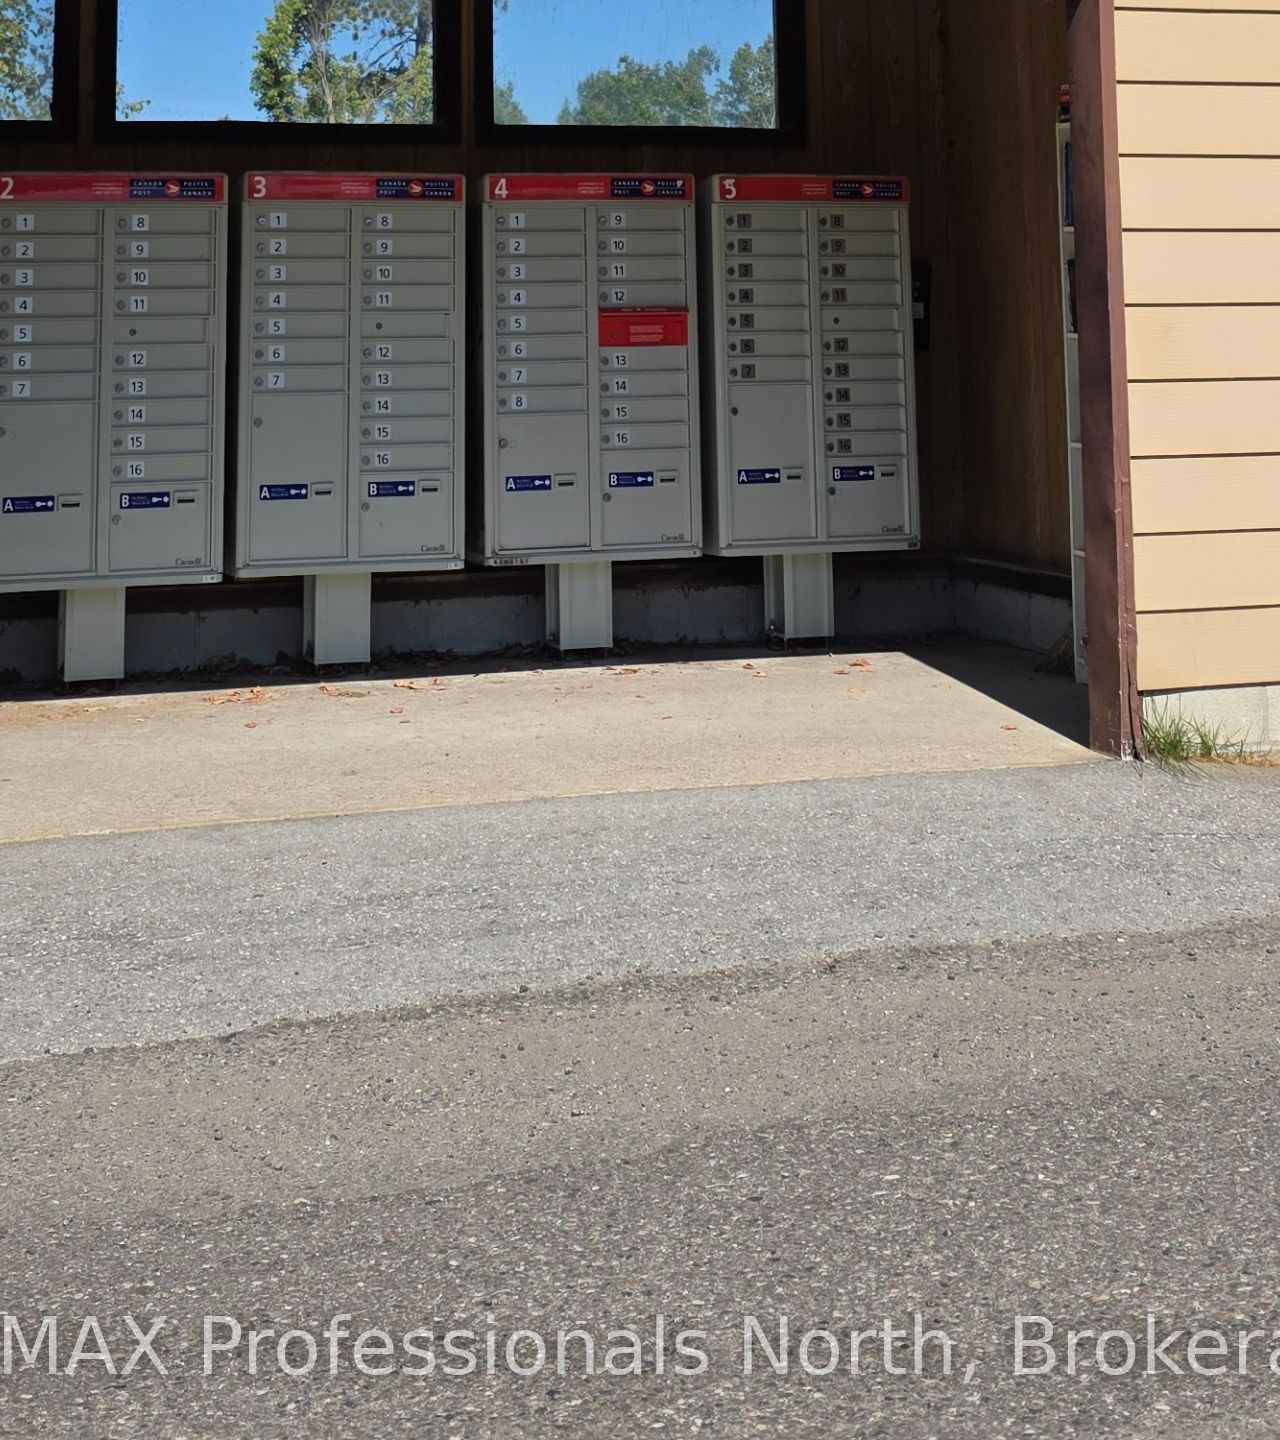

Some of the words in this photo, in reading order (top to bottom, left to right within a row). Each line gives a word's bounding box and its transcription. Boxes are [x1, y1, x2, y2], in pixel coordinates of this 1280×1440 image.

[0, 178, 14, 200] 2
[253, 176, 267, 198] 3
[494, 178, 508, 198] 4
[722, 179, 736, 198] 5
[136, 217, 145, 228] 8
[381, 215, 389, 227] 8
[614, 215, 622, 225] 9
[833, 215, 841, 227] 8
[21, 245, 29, 256] 2
[136, 244, 144, 255] 9
[274, 241, 282, 252] 2
[380, 242, 388, 253] 9
[514, 241, 521, 252] 2
[613, 240, 625, 251] 10
[741, 240, 748, 252] 2
[834, 240, 842, 251] 9
[275, 267, 282, 279] 3
[379, 268, 390, 279] 10
[515, 266, 521, 277] 3
[614, 265, 624, 275] 11
[742, 264, 750, 277] 3
[834, 264, 845, 276] 10
[21, 272, 29, 284] 3
[134, 271, 146, 283] 10
[273, 294, 281, 305] 4
[379, 294, 389, 305] 11
[513, 292, 521, 303] 4
[614, 291, 625, 301] 12
[742, 290, 749, 301] 4
[835, 290, 844, 300] 11
[19, 300, 28, 310] 4
[134, 299, 145, 310] 11
[273, 321, 281, 332] 5
[514, 318, 522, 329] 5
[743, 315, 751, 327] 5
[19, 327, 27, 340] 5
[514, 344, 522, 355] 6
[744, 340, 751, 352] 6
[836, 339, 847, 351] 12
[272, 348, 281, 359] 6
[378, 347, 389, 358] 12
[18, 355, 26, 367] 6
[132, 353, 144, 365] 12
[615, 355, 627, 366] 13
[516, 370, 522, 381] 7
[744, 365, 752, 377] 7
[837, 364, 848, 376] 13
[273, 375, 280, 386] 7
[378, 373, 389, 385] 13
[17, 383, 26, 395] 7
[132, 381, 143, 392] 13
[615, 380, 627, 391] 14
[837, 389, 849, 401] 14
[377, 400, 389, 411] 14
[515, 396, 523, 407] 8
[130, 408, 143, 420] 14
[616, 406, 627, 417] 15
[838, 413, 850, 426] 15
[377, 426, 389, 438] 15
[616, 432, 628, 444] 16
[130, 436, 143, 448] 15
[839, 440, 851, 452] 16
[377, 453, 389, 465] 16
[130, 464, 143, 475] 16
[834, 468, 841, 479] B
[610, 474, 618, 486] B
[739, 470, 748, 482] A
[370, 483, 377, 495] B
[507, 477, 516, 489] A
[260, 486, 270, 498] A
[4, 499, 14, 512] A
[121, 495, 129, 507] B
